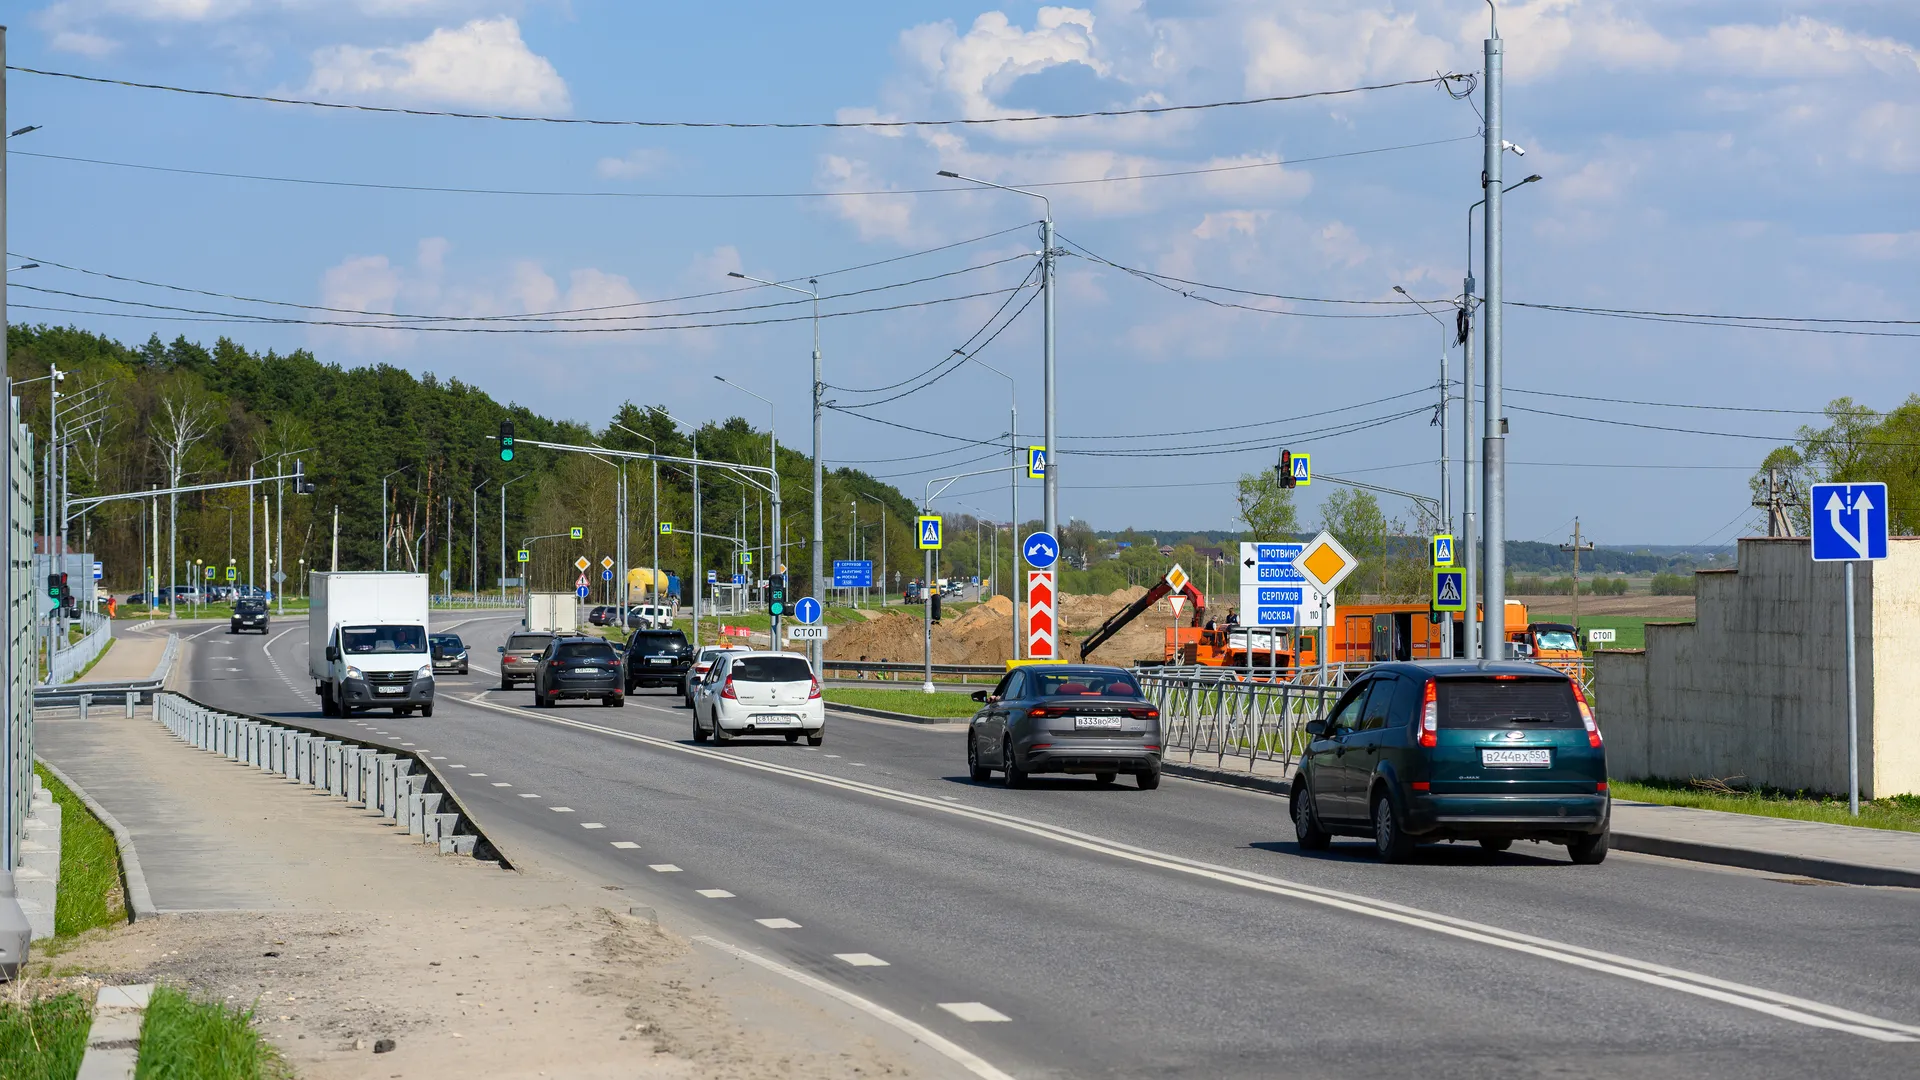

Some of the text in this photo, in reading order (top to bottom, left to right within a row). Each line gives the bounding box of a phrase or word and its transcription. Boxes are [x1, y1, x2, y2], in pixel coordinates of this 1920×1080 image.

[1261, 549, 1299, 558] ПРОТВИНО
[1262, 592, 1298, 600] СЕРПУХОВ
[1261, 611, 1318, 620] МОСКВА 110
[1486, 752, 1528, 761] В244ВХ
